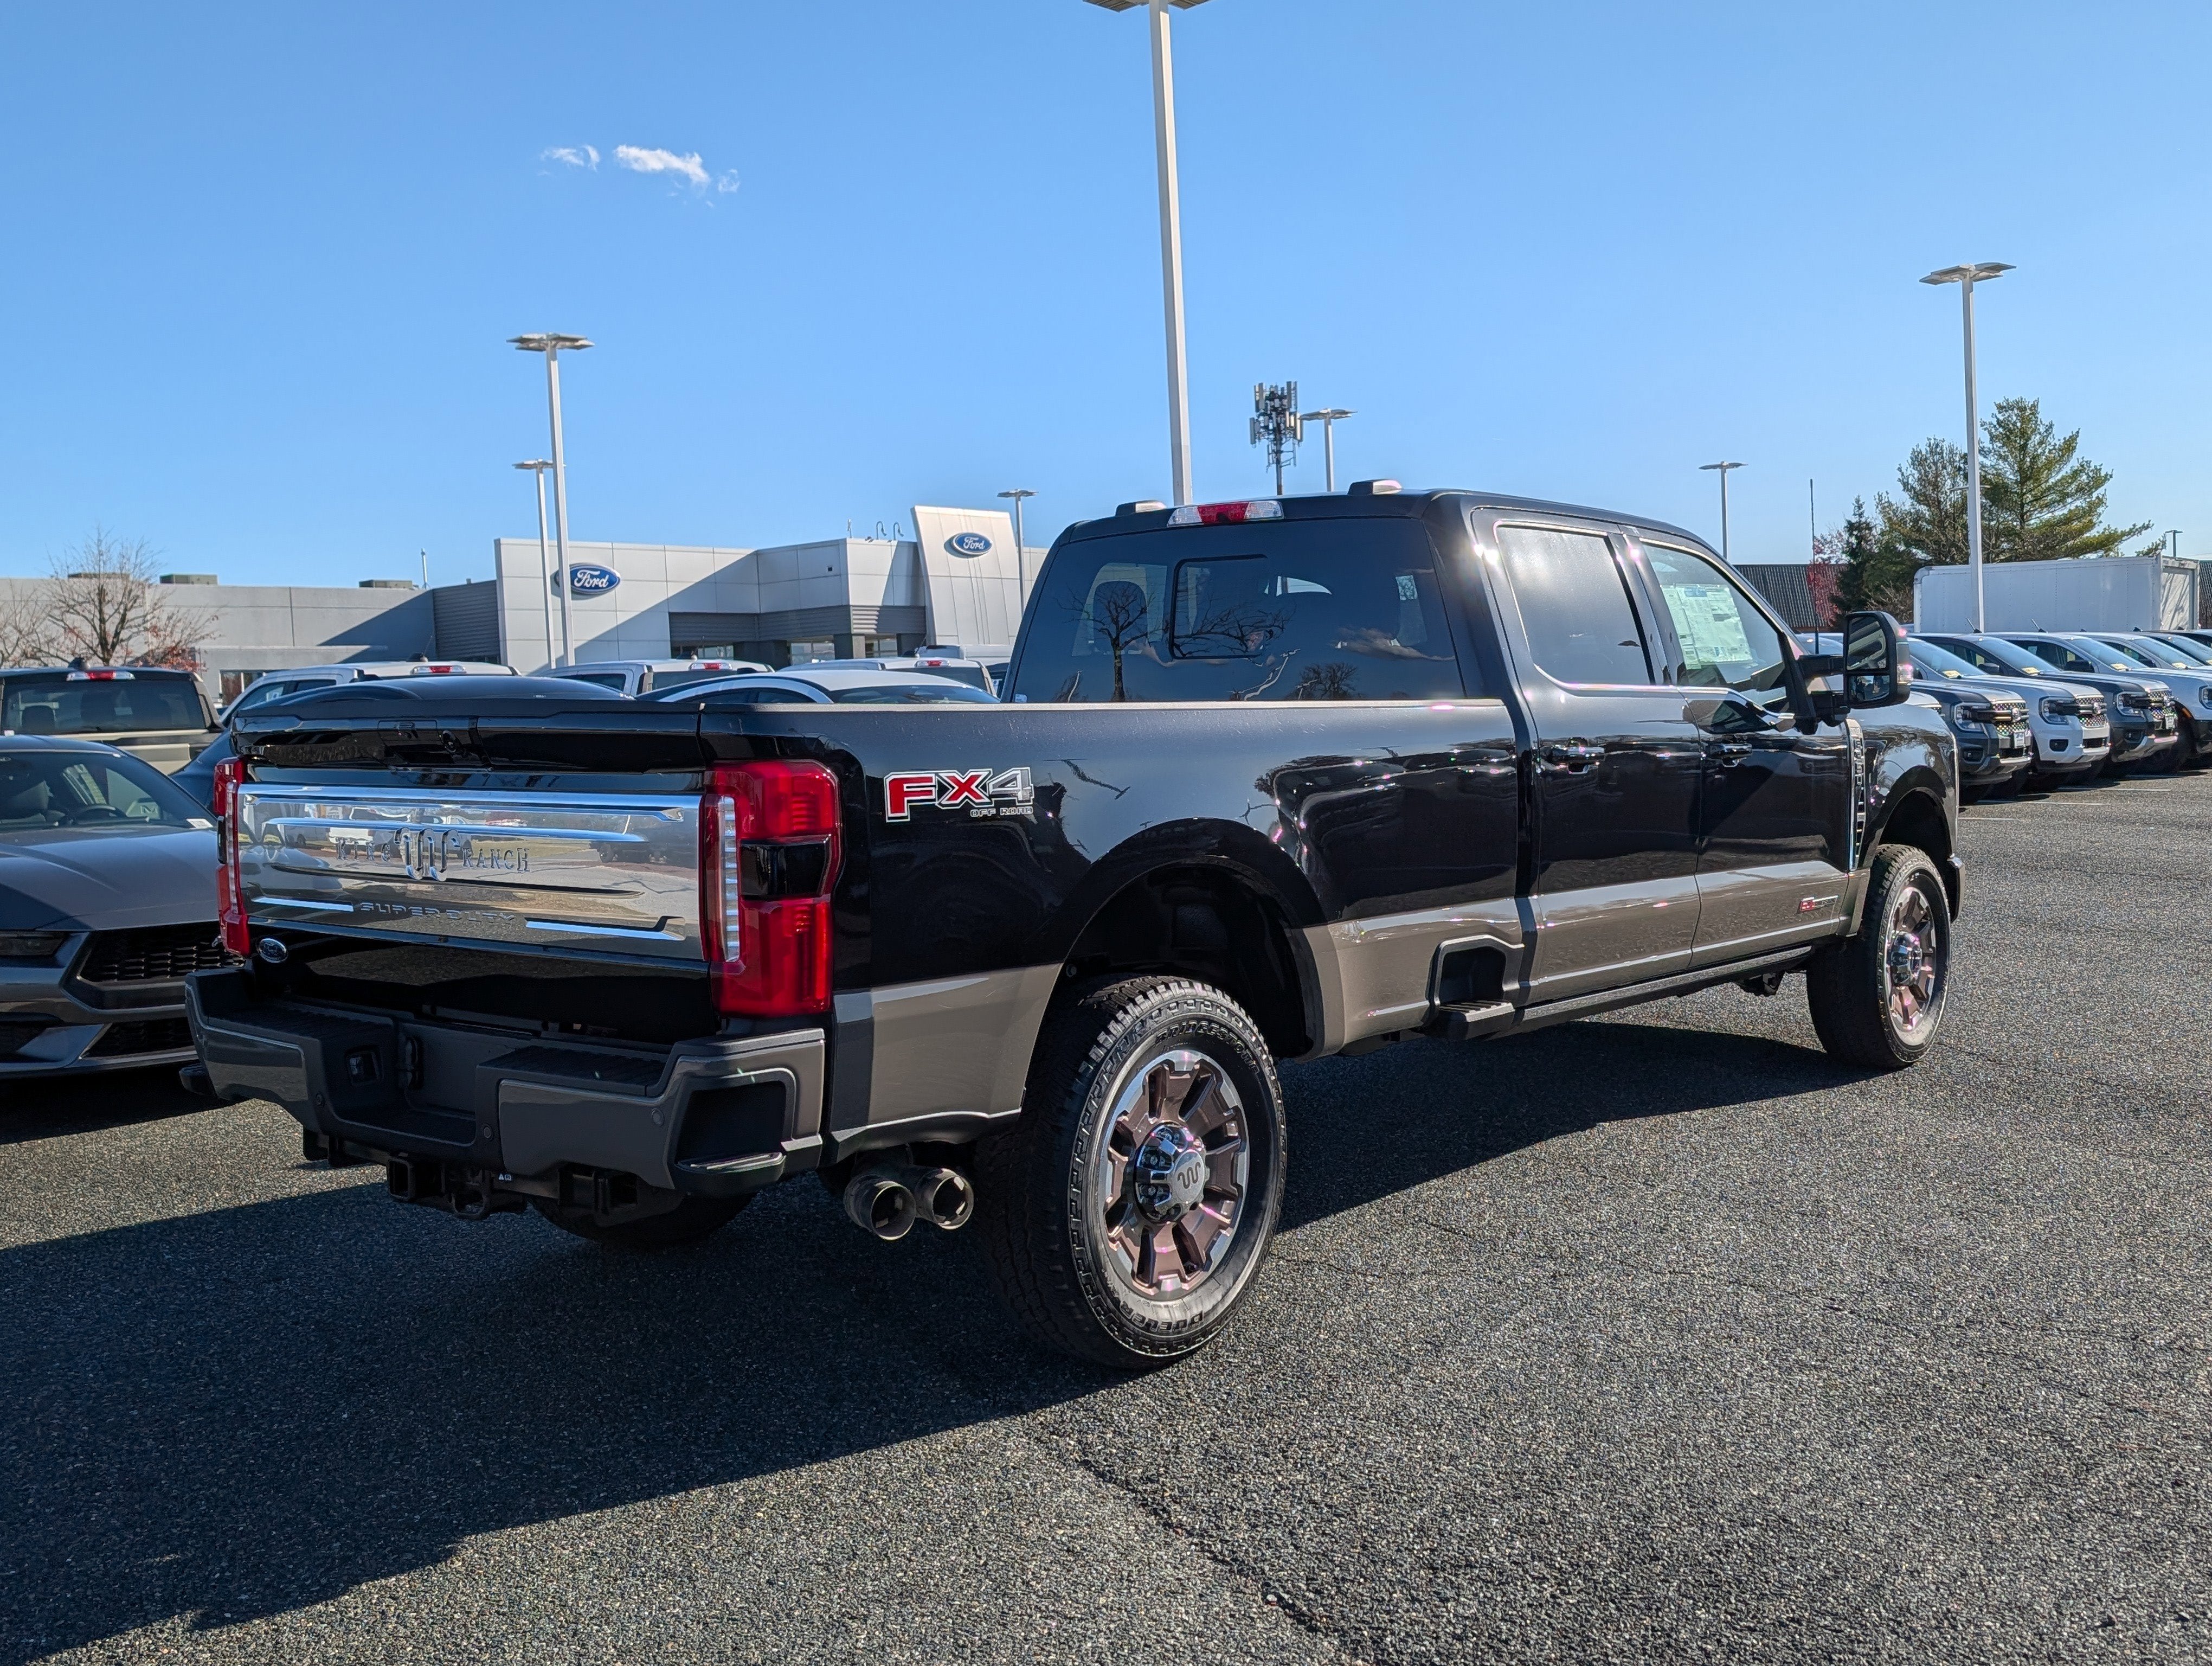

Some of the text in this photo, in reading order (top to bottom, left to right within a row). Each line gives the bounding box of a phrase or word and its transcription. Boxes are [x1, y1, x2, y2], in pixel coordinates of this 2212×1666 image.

[963, 536, 986, 550] Ford
[574, 569, 609, 588] Ford
[884, 767, 1034, 822] FX4
[970, 806, 1033, 817] OFF ROAD
[336, 837, 531, 873] KING RANCH
[360, 902, 441, 919] SUPER
[1154, 1020, 1261, 1074] BRIDGESTONE
[1119, 1300, 1203, 1332] DUELER
